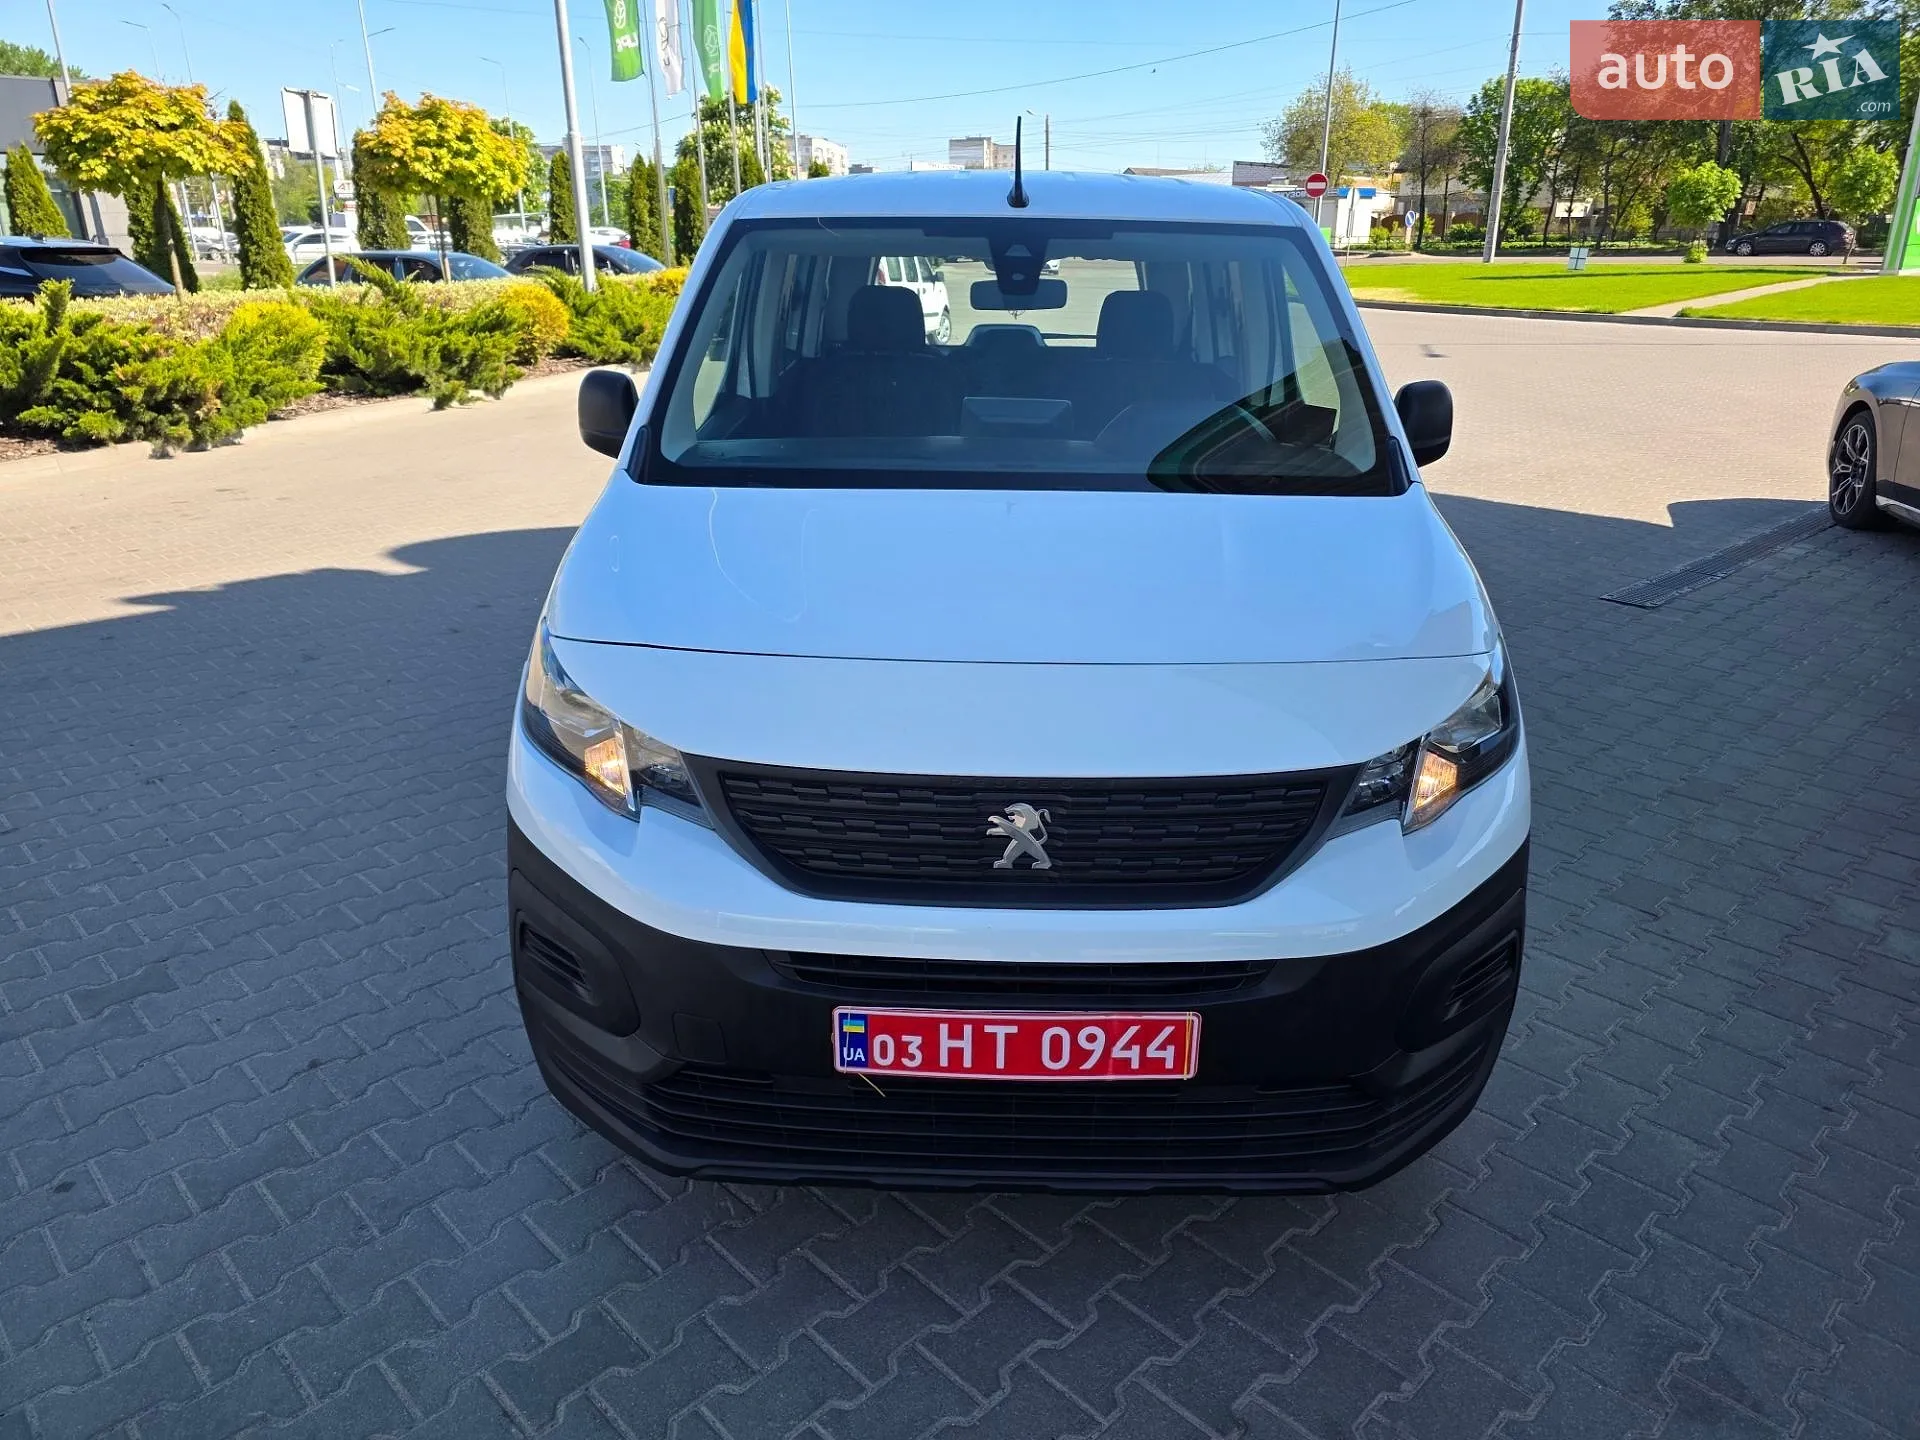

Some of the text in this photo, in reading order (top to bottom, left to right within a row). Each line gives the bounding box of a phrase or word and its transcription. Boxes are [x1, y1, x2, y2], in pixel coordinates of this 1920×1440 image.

[843, 1046, 866, 1062] UA
[873, 1022, 1176, 1070] 03 HT 0944
